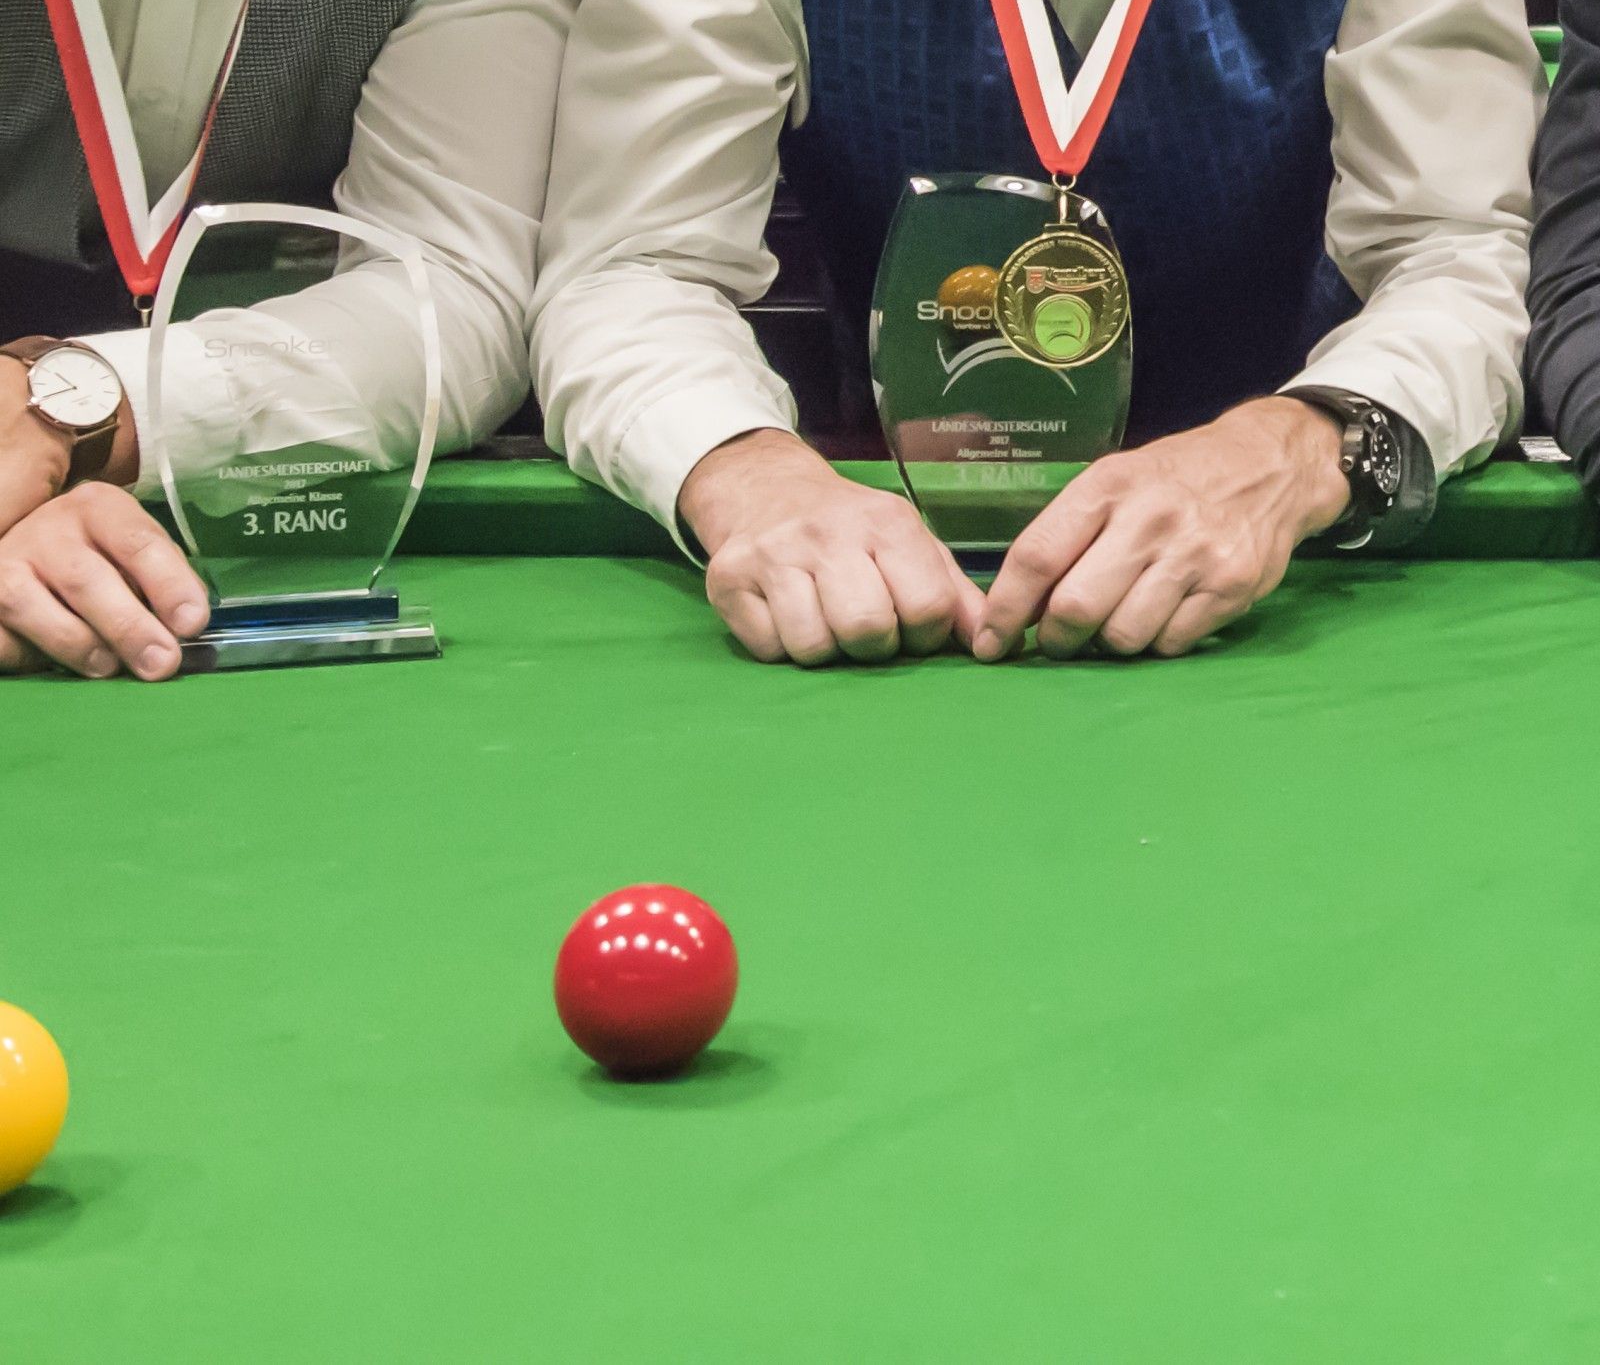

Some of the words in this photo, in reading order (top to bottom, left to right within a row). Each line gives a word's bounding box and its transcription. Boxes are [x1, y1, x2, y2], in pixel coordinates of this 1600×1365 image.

[916, 300, 995, 321] Snoo
[243, 511, 265, 536] 3.
[274, 507, 347, 534] RANG
